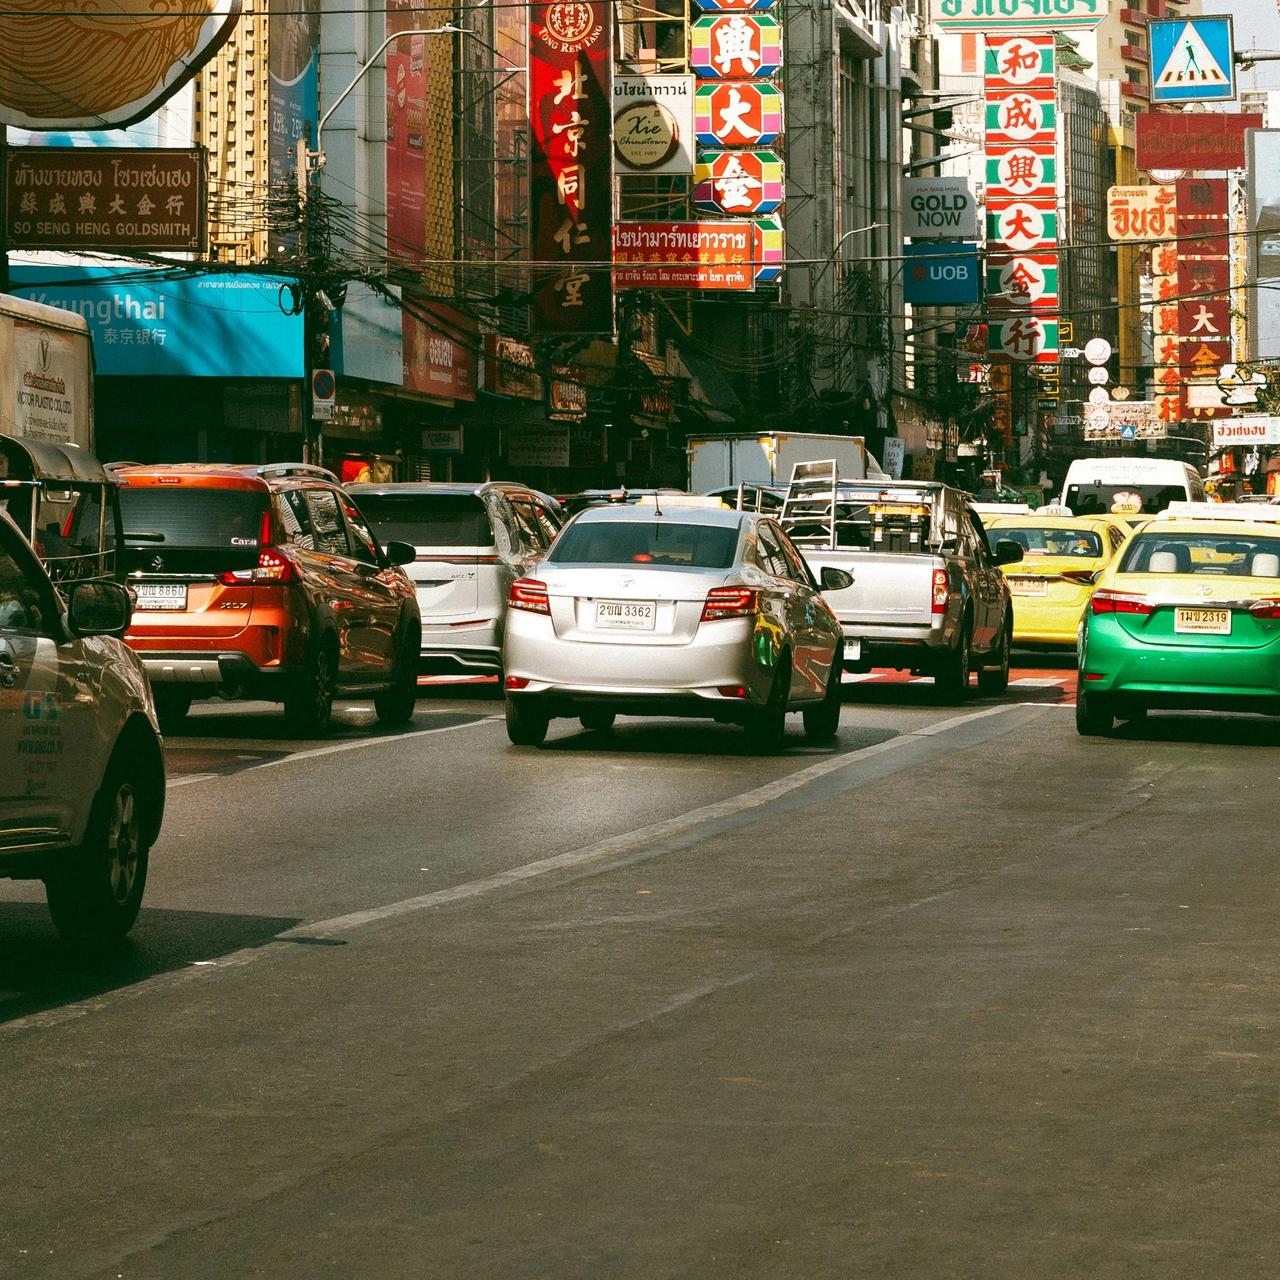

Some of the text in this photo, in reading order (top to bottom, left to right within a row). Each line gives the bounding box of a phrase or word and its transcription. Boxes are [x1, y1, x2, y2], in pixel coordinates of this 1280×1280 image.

[538, 25, 603, 53] TONG REN TANG
[627, 115, 662, 135] Xie
[619, 136, 668, 145] Chinatown
[15, 162, 103, 187] ห้างขายทอง
[552, 59, 591, 308] 北京同仁堂
[910, 194, 968, 212] GOLD
[1000, 43, 1041, 354] 和成興大金行
[917, 212, 961, 227] NOW
[14, 221, 191, 237] SO SENG HENG GOLDSMITH
[930, 266, 969, 280] UOB
[104, 328, 167, 346] 泰京银行
[158, 585, 185, 597] 8860
[624, 606, 652, 619] 3362
[1202, 611, 1228, 623] 2319
